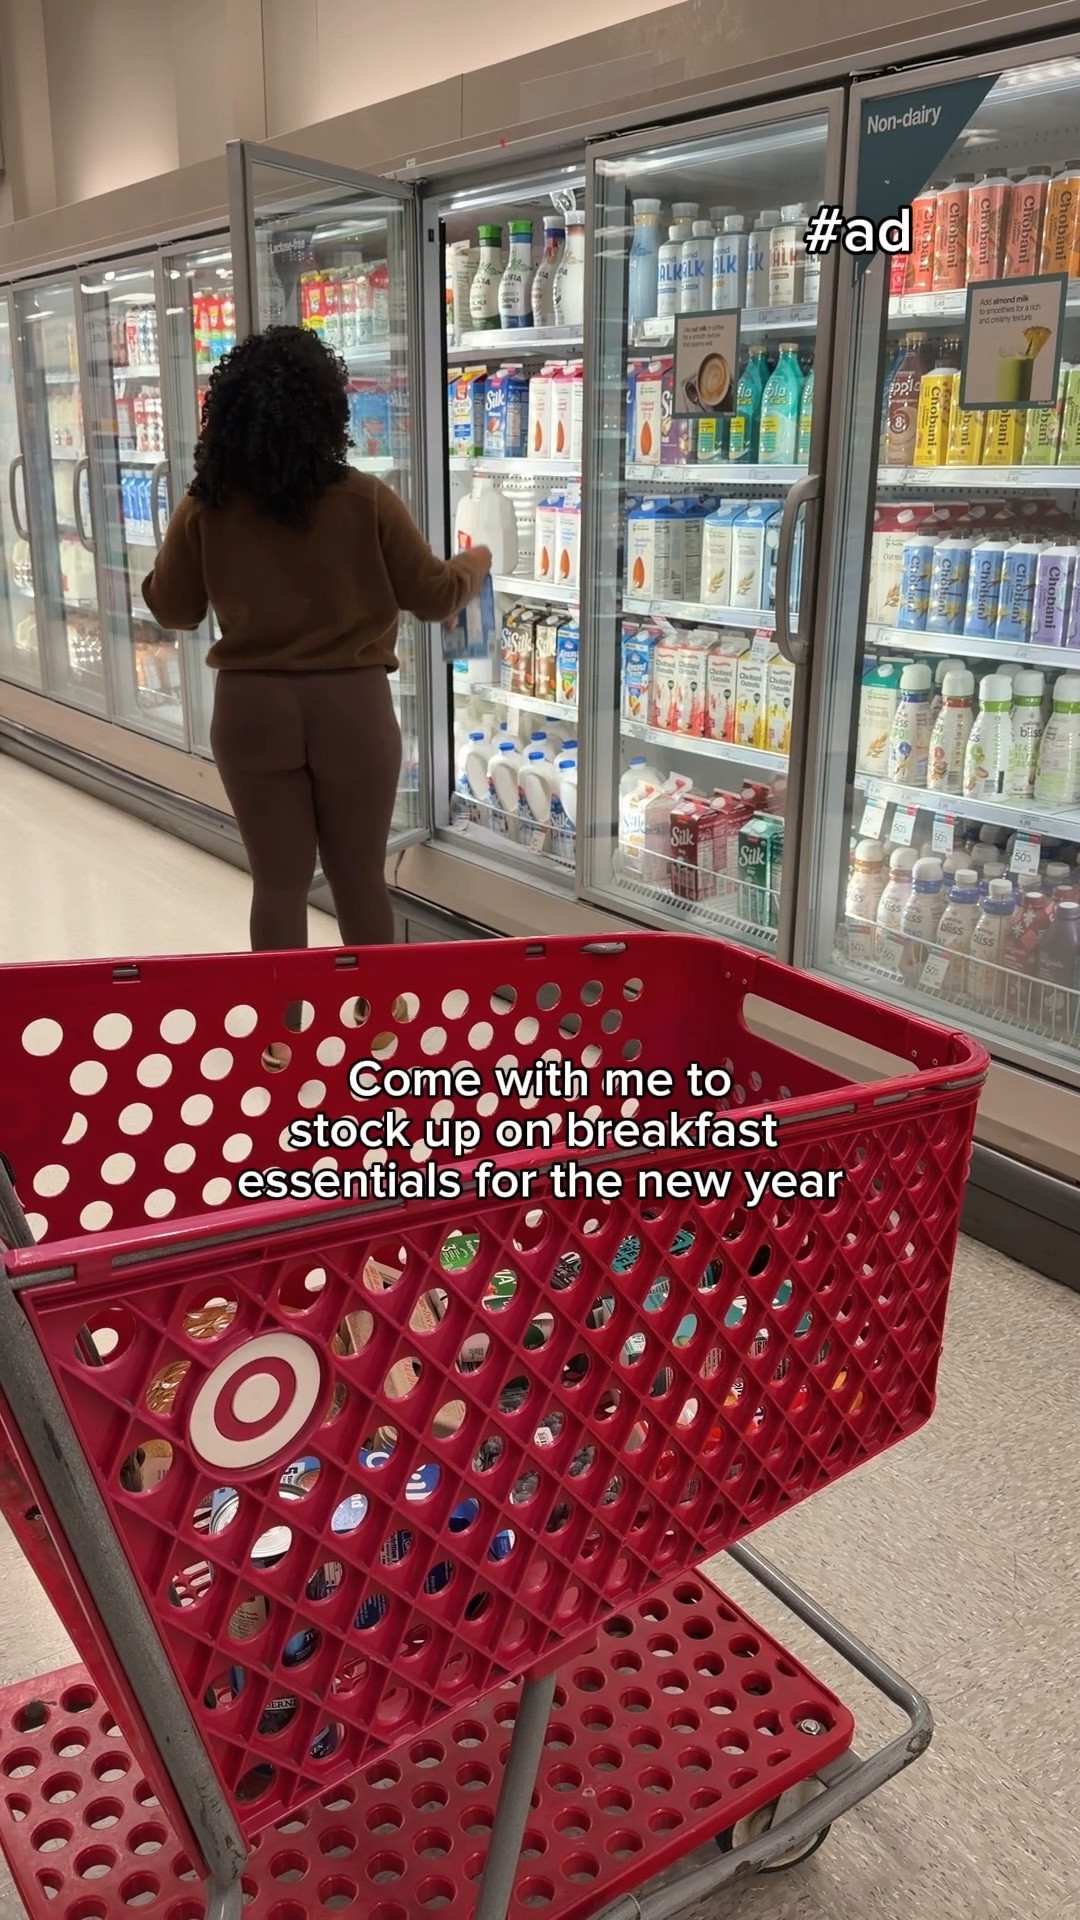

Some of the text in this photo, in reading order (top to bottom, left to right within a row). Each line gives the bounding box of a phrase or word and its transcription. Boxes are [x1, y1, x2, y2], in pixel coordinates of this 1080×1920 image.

[867, 104, 943, 135] Non-dairy
[947, 202, 960, 268] Chobani
[979, 197, 991, 265] Chobani
[1018, 195, 1035, 264] Chobani
[1055, 190, 1072, 261] Chobani
[993, 296, 1016, 305] almond
[1016, 294, 1029, 303] milk
[485, 388, 505, 411] Silk
[927, 386, 941, 447] Chobani
[1044, 566, 1061, 630] Chobani
[670, 826, 695, 847] Silk
[738, 845, 766, 866] Silk
[940, 921, 964, 937] bliss
